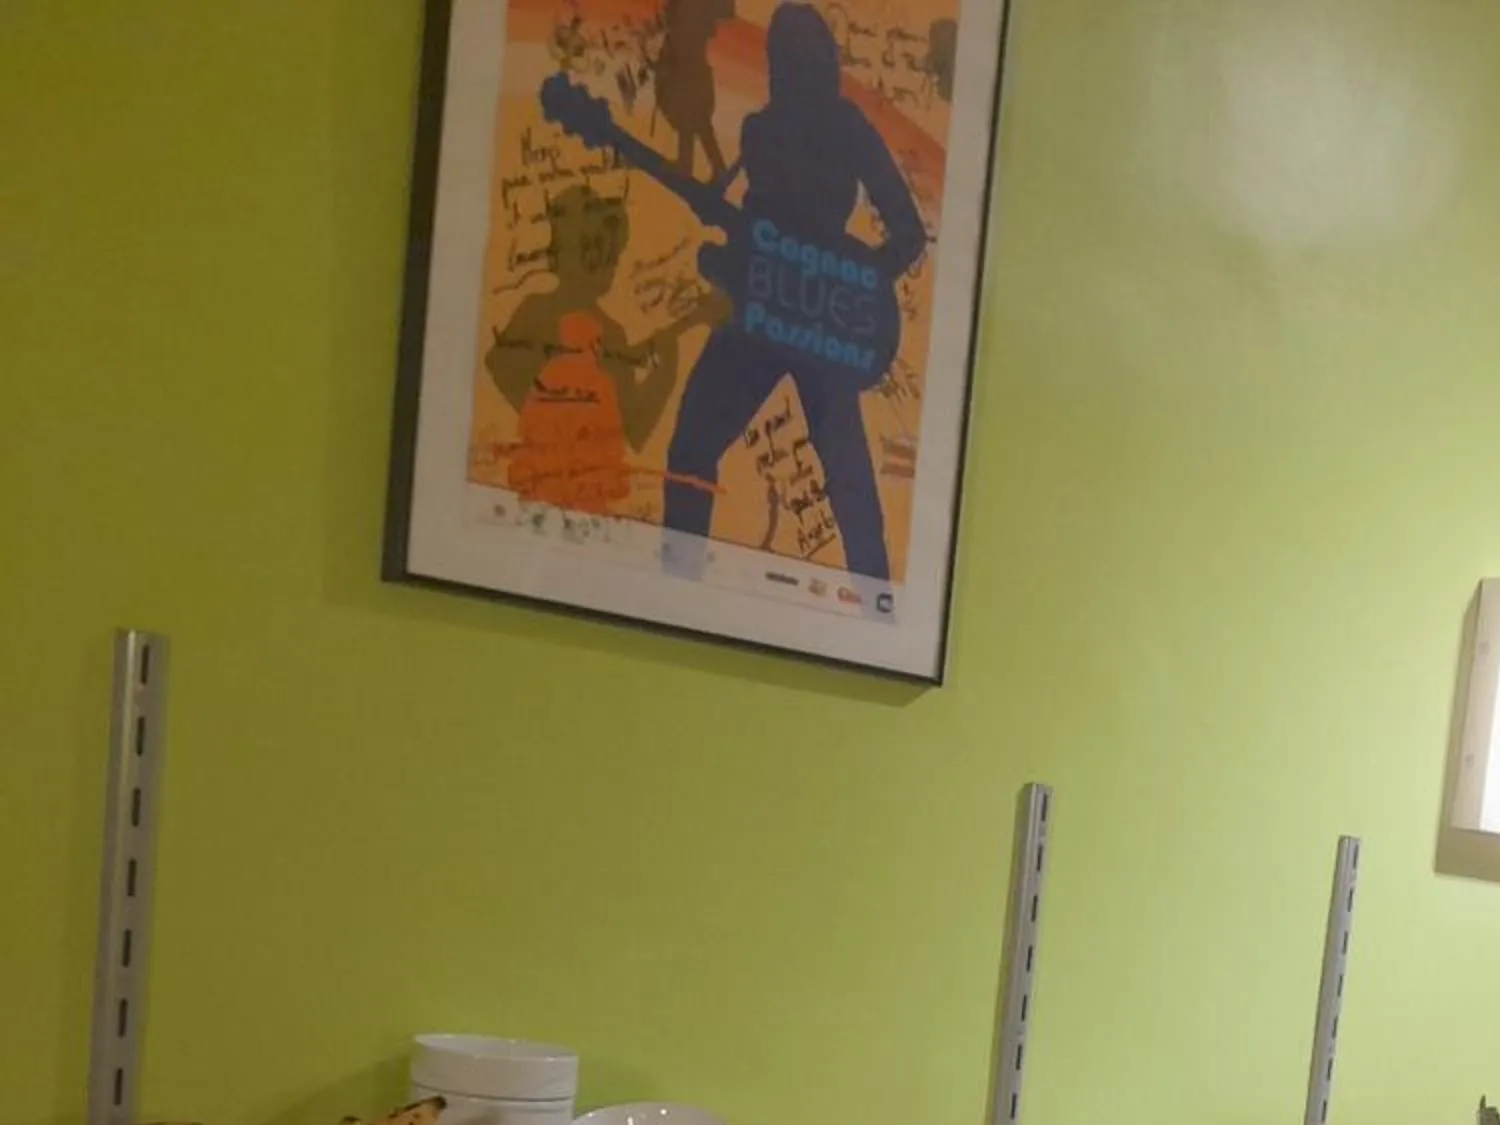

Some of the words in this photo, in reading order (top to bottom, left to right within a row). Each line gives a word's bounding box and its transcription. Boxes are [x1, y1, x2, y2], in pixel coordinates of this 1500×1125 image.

[752, 218, 878, 290] Cognac
[748, 254, 878, 336] BLUES
[745, 300, 877, 372] Passions
